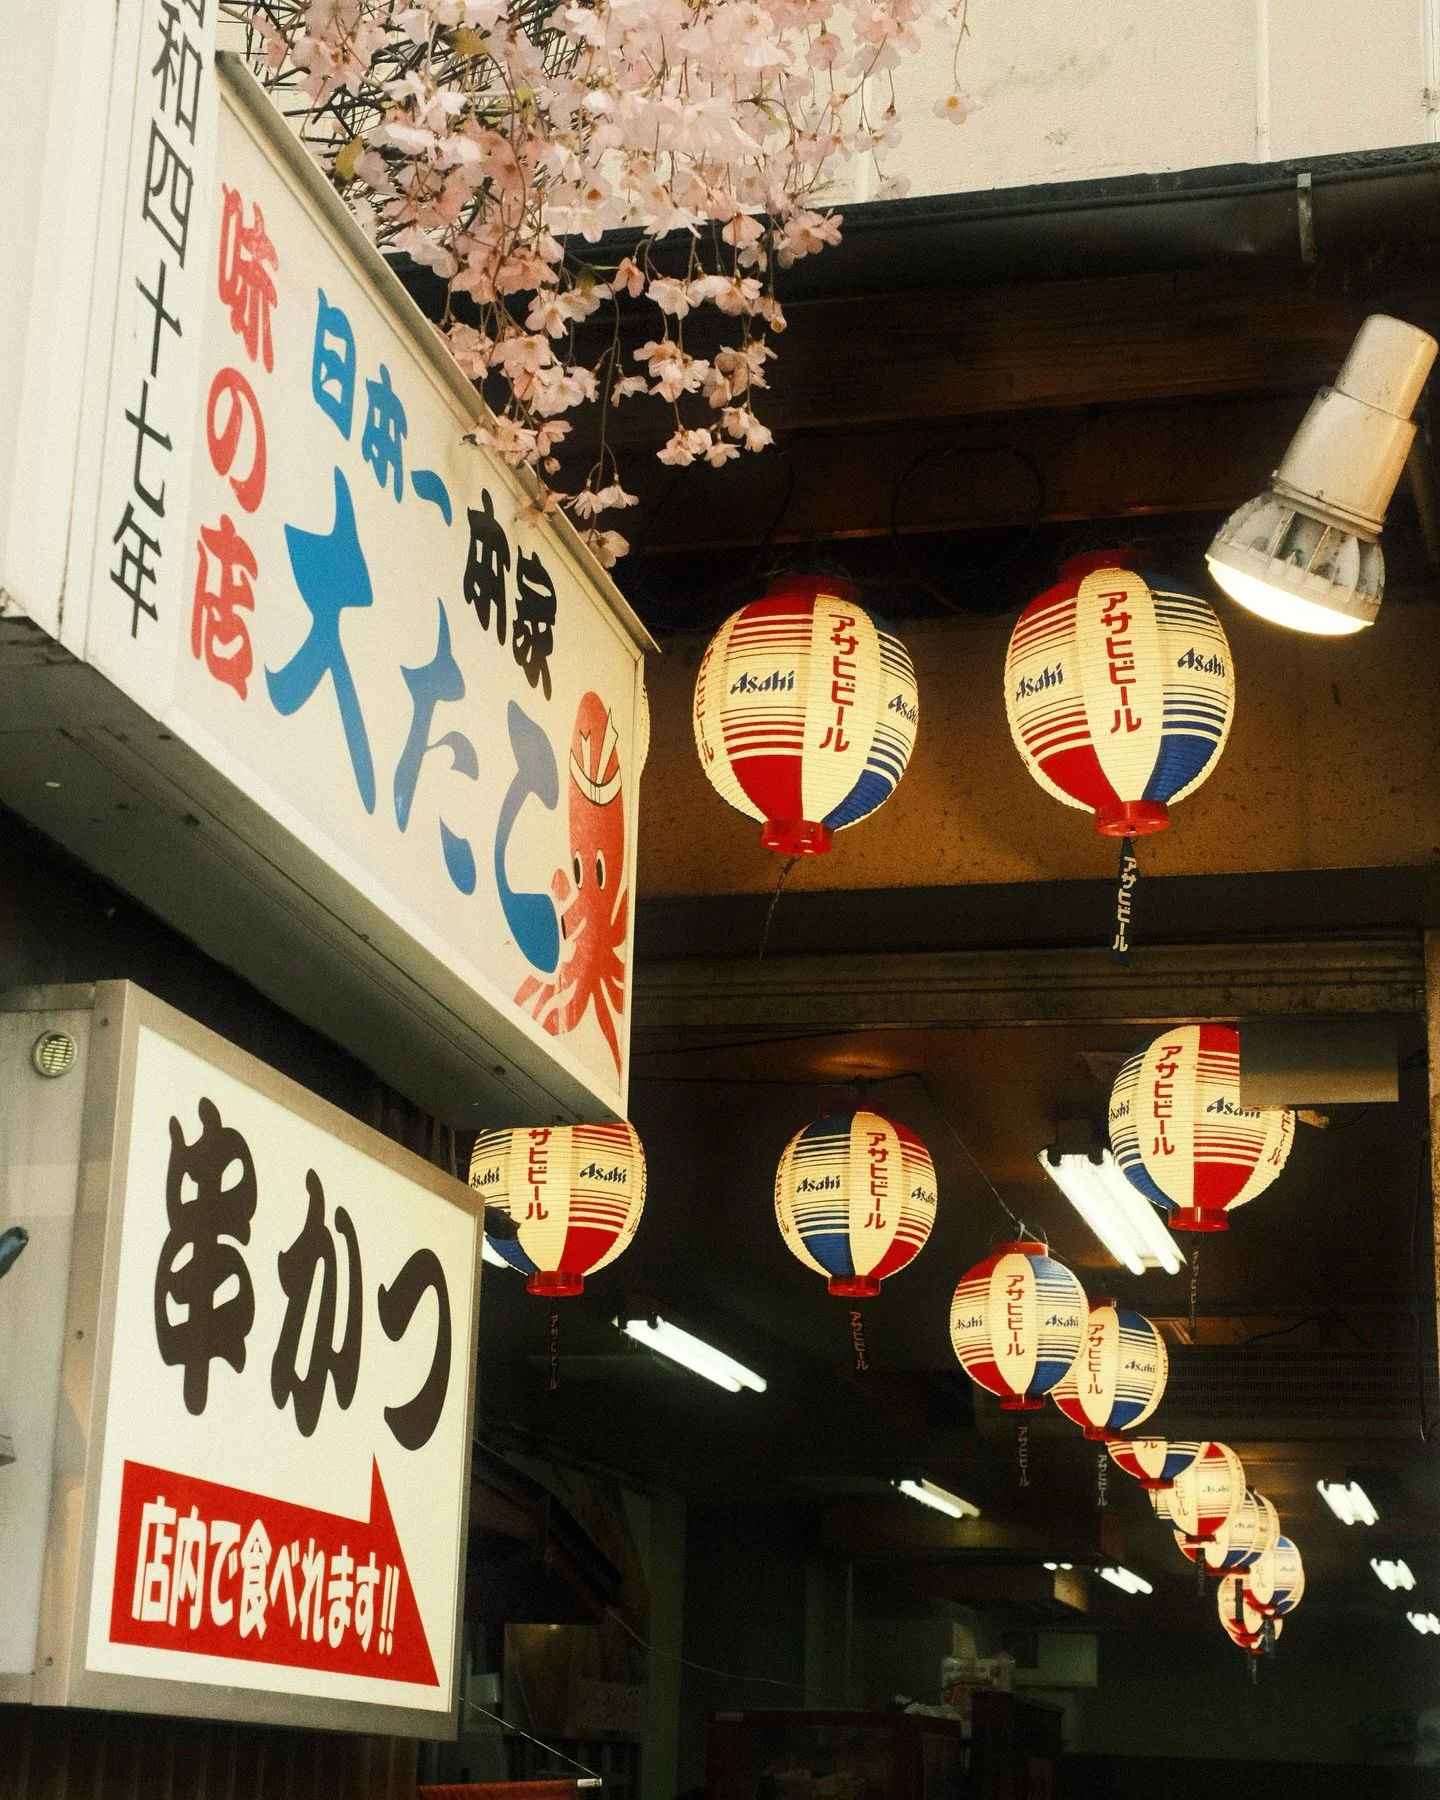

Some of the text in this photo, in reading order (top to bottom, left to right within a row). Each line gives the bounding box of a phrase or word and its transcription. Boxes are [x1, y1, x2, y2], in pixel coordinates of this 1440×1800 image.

[110, 0, 205, 639] 和四十七年
[191, 182, 279, 701] 味の店
[312, 287, 452, 526] 日本一
[463, 488, 557, 700] 本家
[730, 670, 795, 695] Asahi
[819, 614, 860, 752] アサヒビール
[1015, 662, 1063, 701] Asahi
[1098, 591, 1142, 734] アサヒビール
[1177, 647, 1226, 678] Asahi
[264, 466, 560, 973] 大たこ
[1112, 856, 1137, 952] アサヒビール
[1152, 1045, 1183, 1156] アサヒビール
[579, 1162, 628, 1184] Asahi
[796, 1174, 841, 1194] Asahi
[864, 1132, 889, 1229] アサヒビール
[154, 1096, 452, 1451] 串かつ
[1006, 1275, 1025, 1357] アサヒビール
[1045, 1314, 1079, 1329] Asahi
[955, 1314, 983, 1330] Asahi
[1088, 1324, 1105, 1395] アサヒビール
[1125, 1360, 1156, 1374] Asahi
